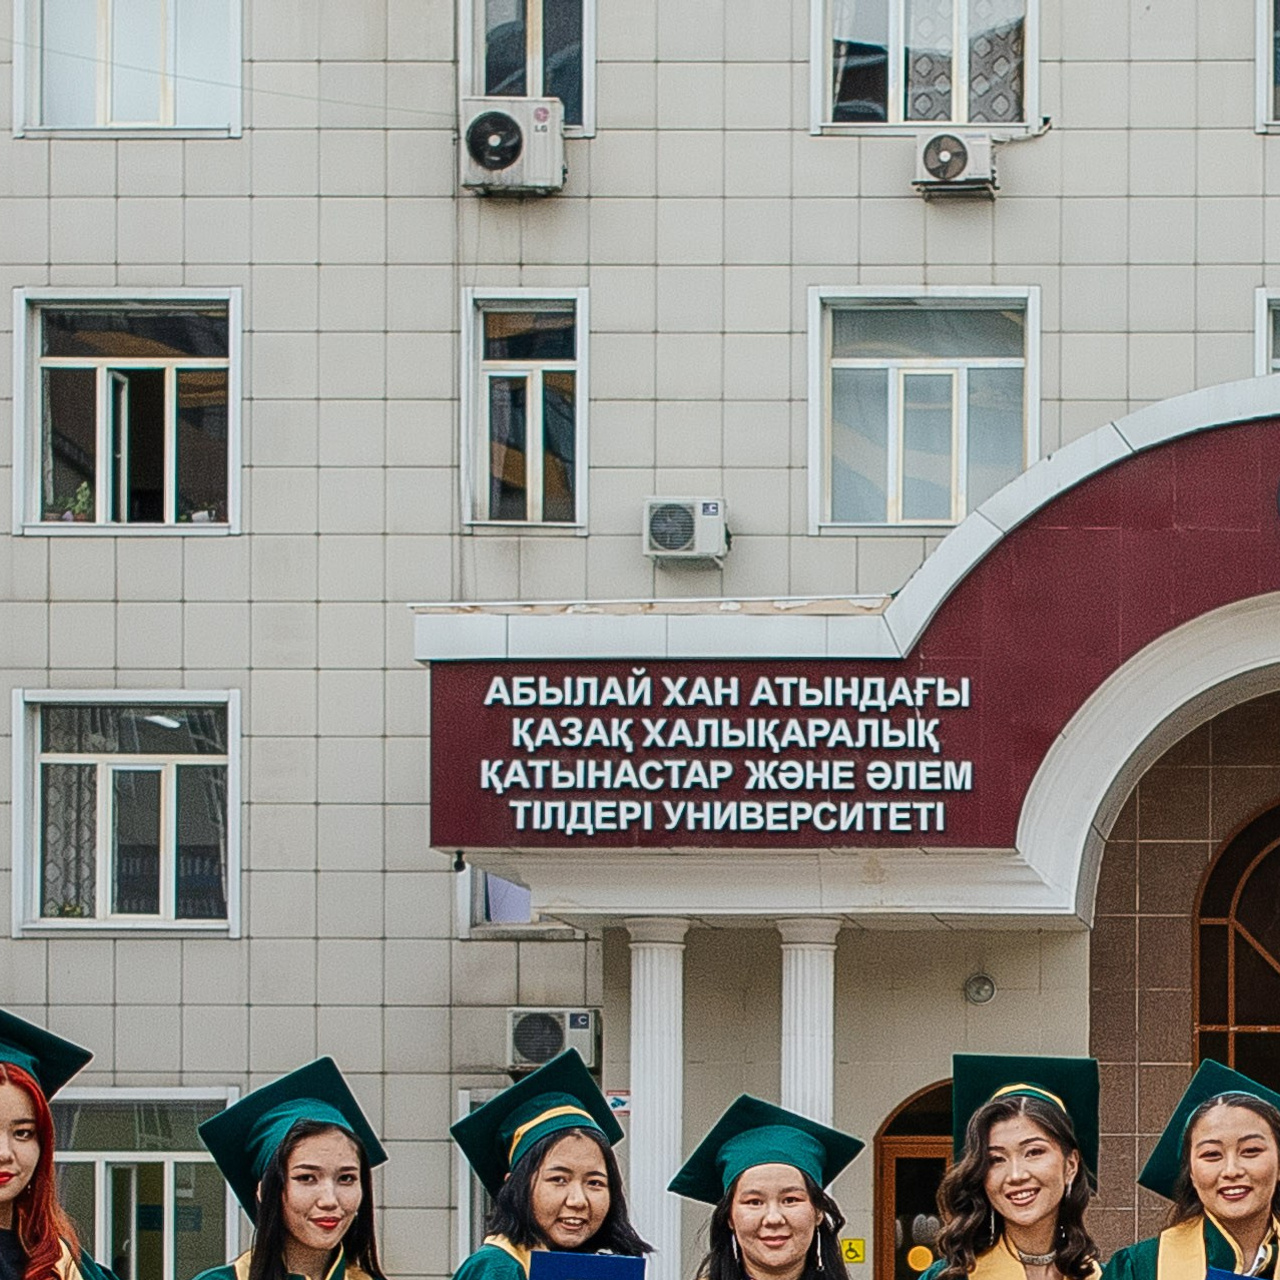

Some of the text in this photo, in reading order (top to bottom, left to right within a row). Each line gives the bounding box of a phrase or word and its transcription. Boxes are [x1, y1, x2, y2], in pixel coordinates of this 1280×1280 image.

[534, 124, 548, 132] LG
[484, 667, 970, 712] АБЫЛАЙ ХАН АТЫНДАҒЫ
[512, 717, 940, 754] ҚАЗАҚ ХАЛЫҚАРАЛЫҚ
[480, 759, 972, 795] ҚАТЫНАСТАР ЖӘНЕ ӘЛЕМ
[508, 800, 944, 836] ТІЛДЕРІ УНИВЕРСИТЕТІ
